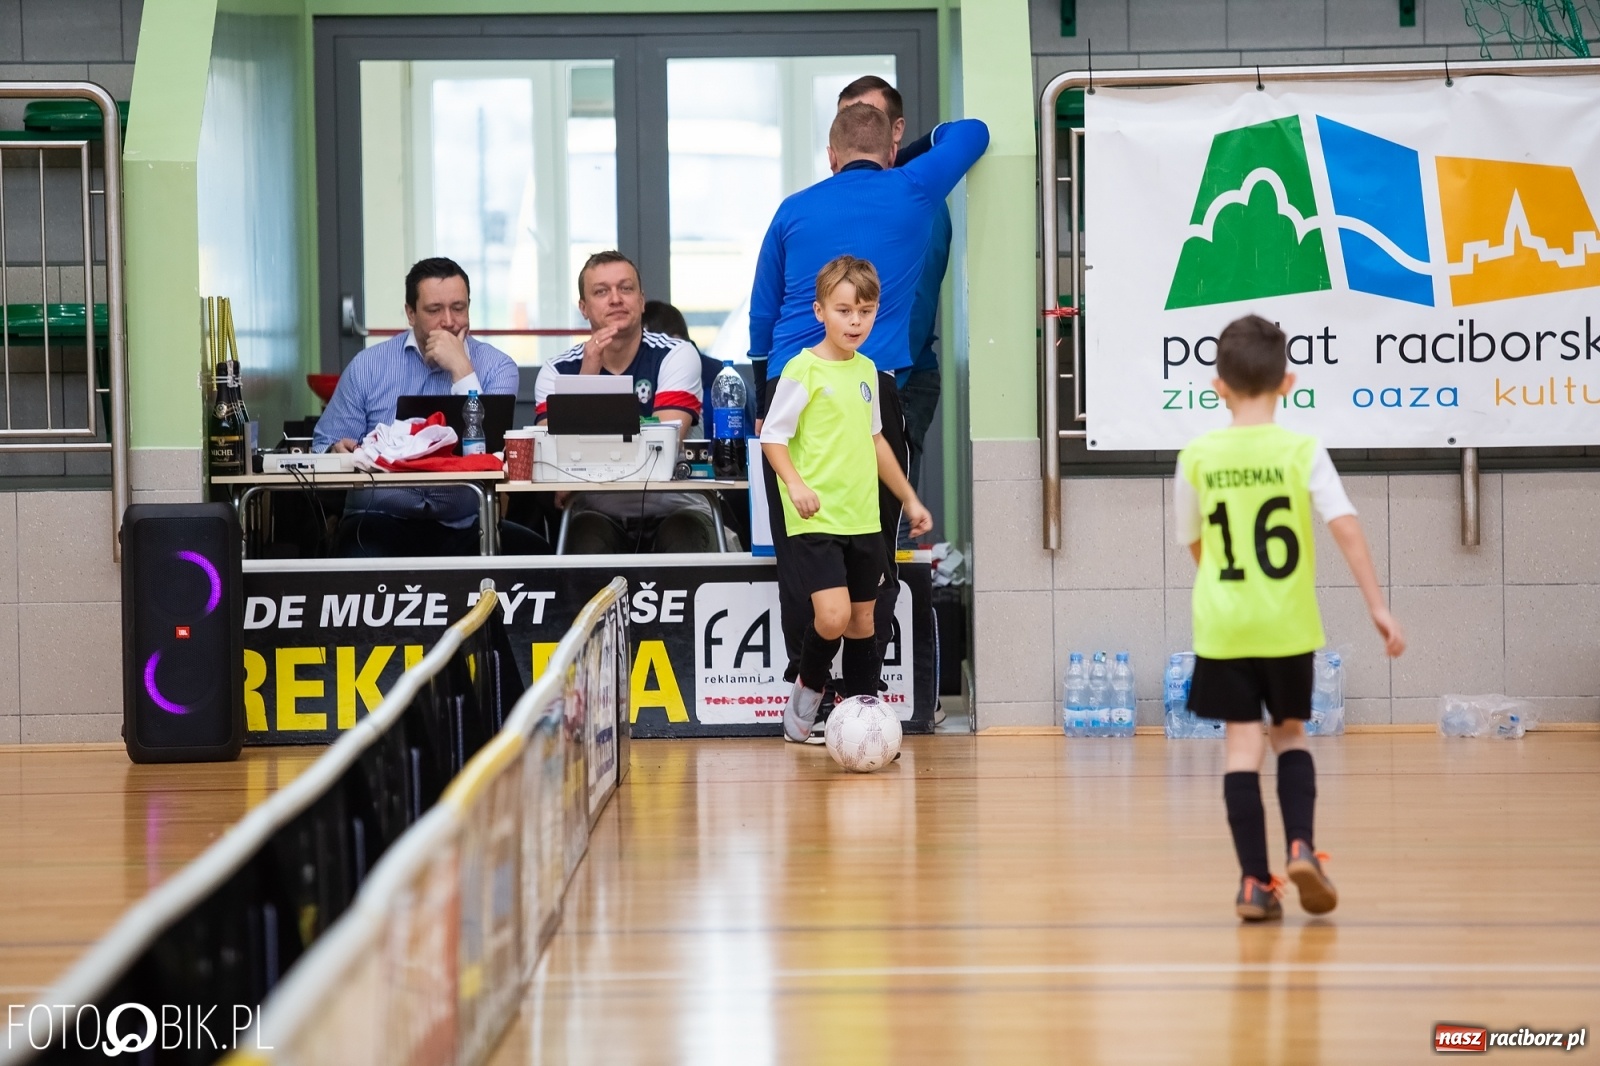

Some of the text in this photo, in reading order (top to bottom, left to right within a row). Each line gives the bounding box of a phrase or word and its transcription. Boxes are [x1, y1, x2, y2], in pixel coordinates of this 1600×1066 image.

[1163, 316, 1600, 379] poat raciborsk
[1162, 381, 1316, 410] ziea
[1352, 385, 1460, 409] oaza
[1208, 496, 1300, 581] 16
[319, 584, 449, 628] MŮŽE
[243, 640, 690, 732] REKA
[767, 696, 790, 705] 707
